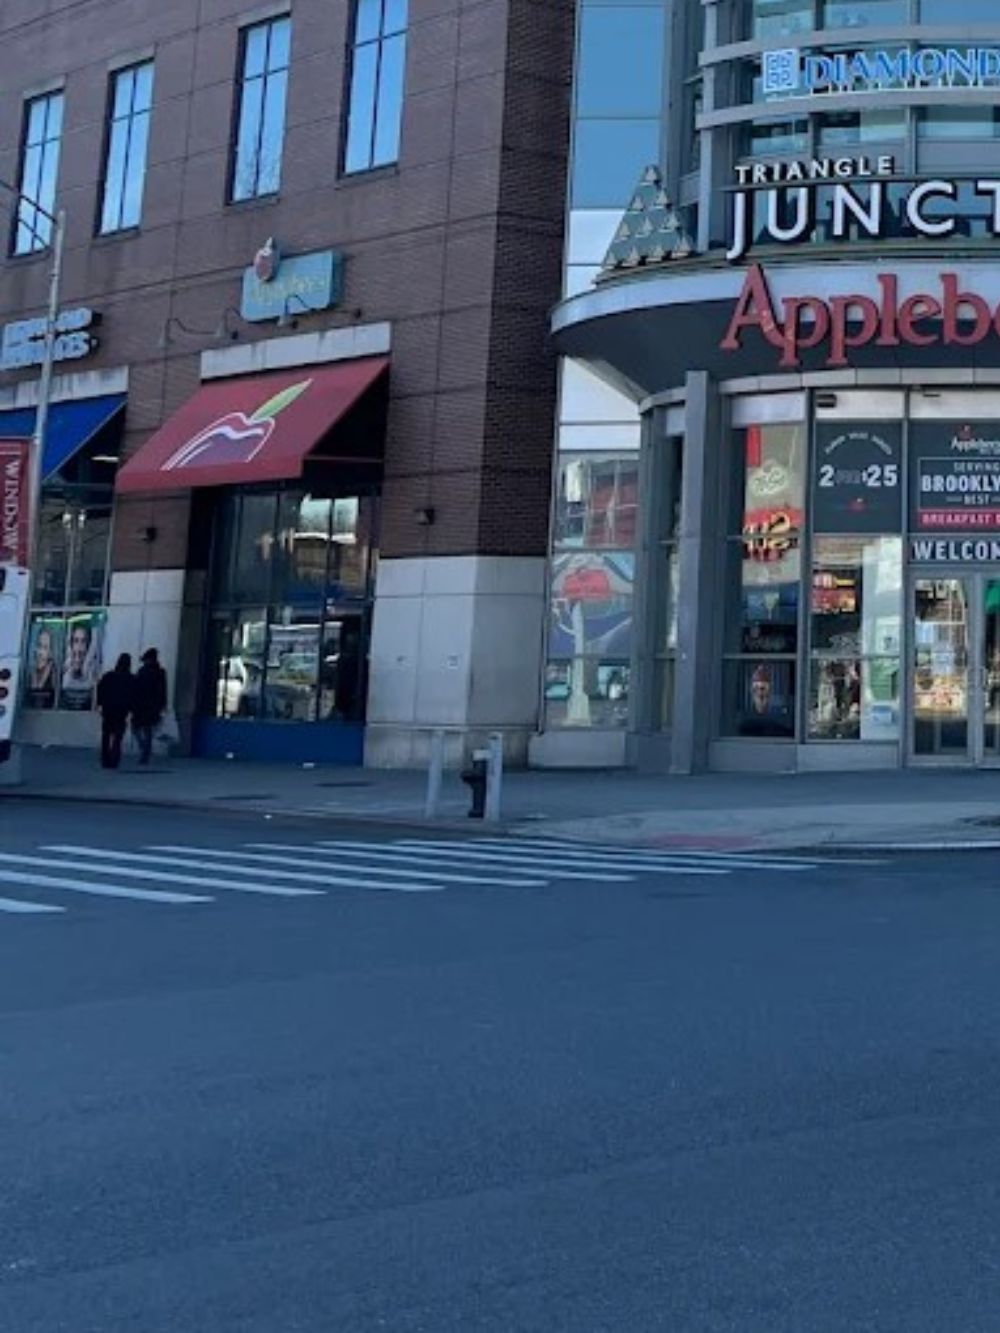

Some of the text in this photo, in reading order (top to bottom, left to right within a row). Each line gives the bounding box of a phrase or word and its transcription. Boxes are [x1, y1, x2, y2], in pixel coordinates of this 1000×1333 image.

[734, 155, 894, 184] TRIANGLE
[952, 462, 1000, 473] SERVING
[819, 464, 834, 487] 2
[963, 494, 991, 506] BEST
[921, 513, 992, 525] BREAKFAST
